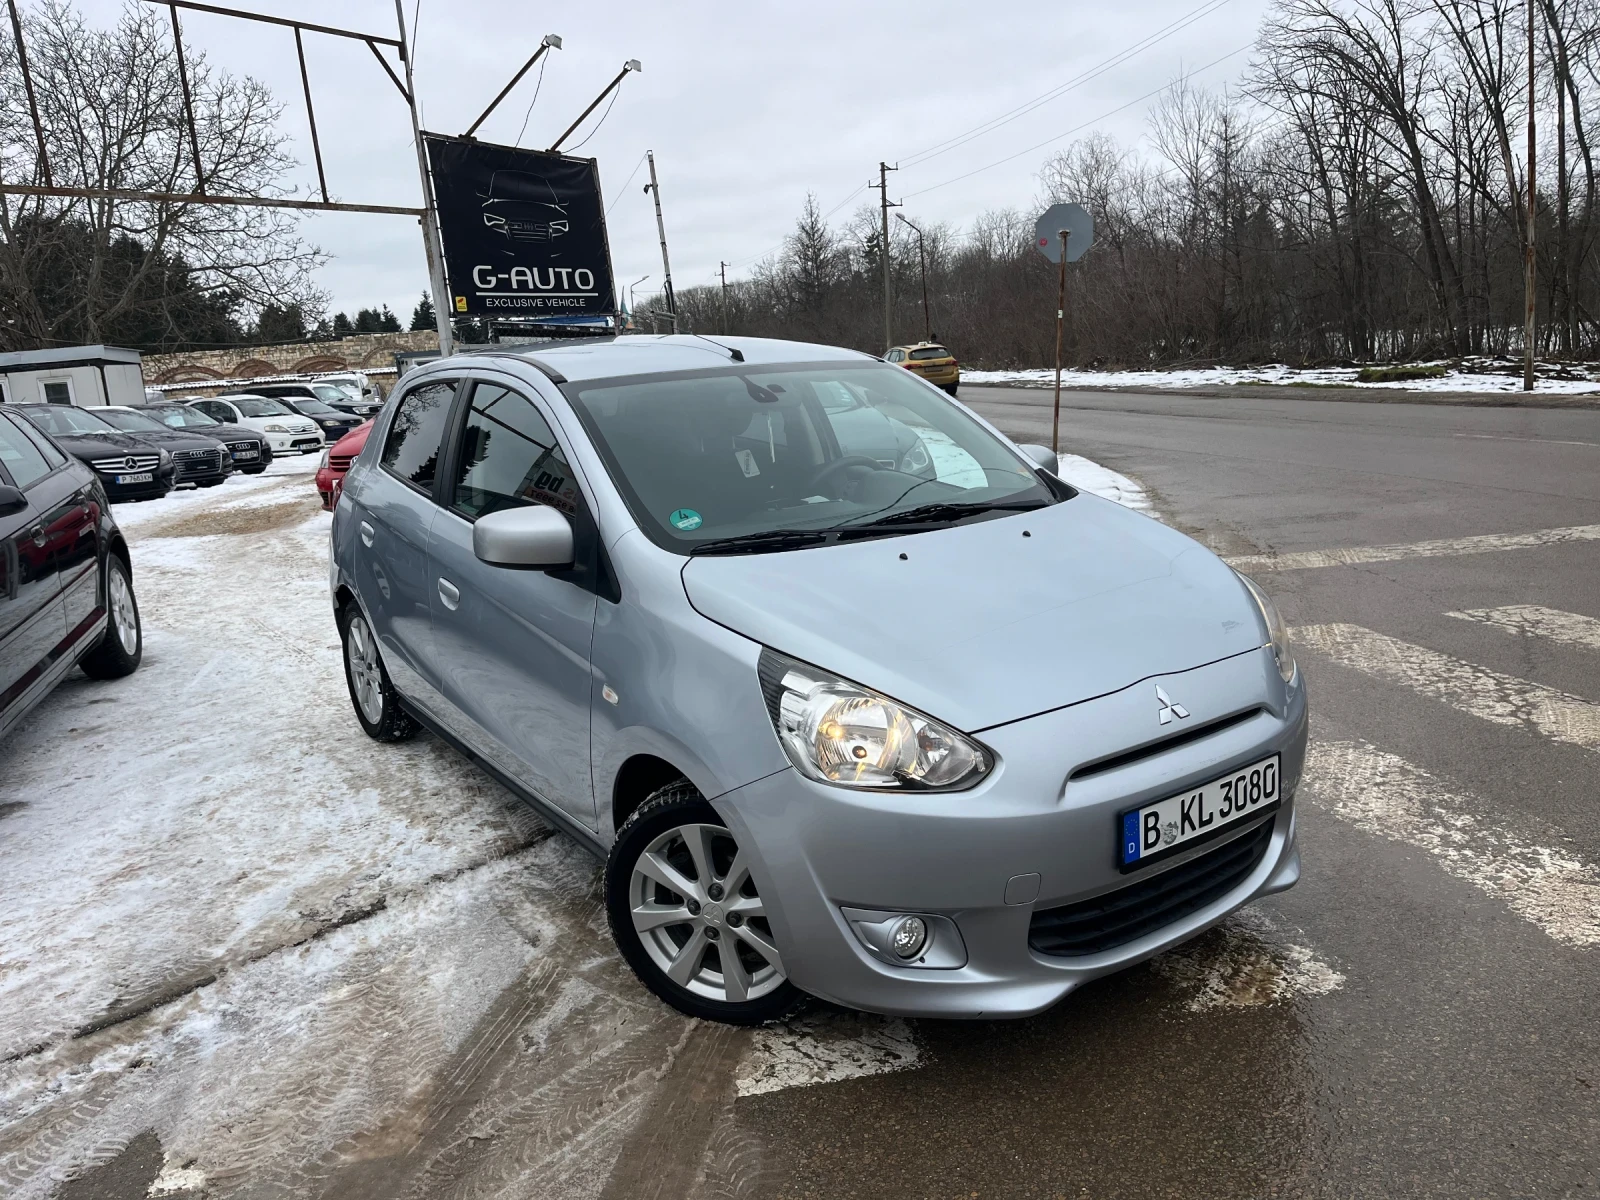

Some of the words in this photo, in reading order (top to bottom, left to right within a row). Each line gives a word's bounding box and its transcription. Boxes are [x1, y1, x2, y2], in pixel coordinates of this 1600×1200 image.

[472, 265, 595, 290] G-AUTO
[486, 298, 543, 307] EXCLUSIVE
[546, 298, 586, 307] VEHICLE
[678, 510, 689, 519] 4
[1143, 810, 1161, 851] B
[1180, 792, 1213, 836] KL
[1219, 763, 1275, 818] 3080
[1128, 842, 1135, 854] D
